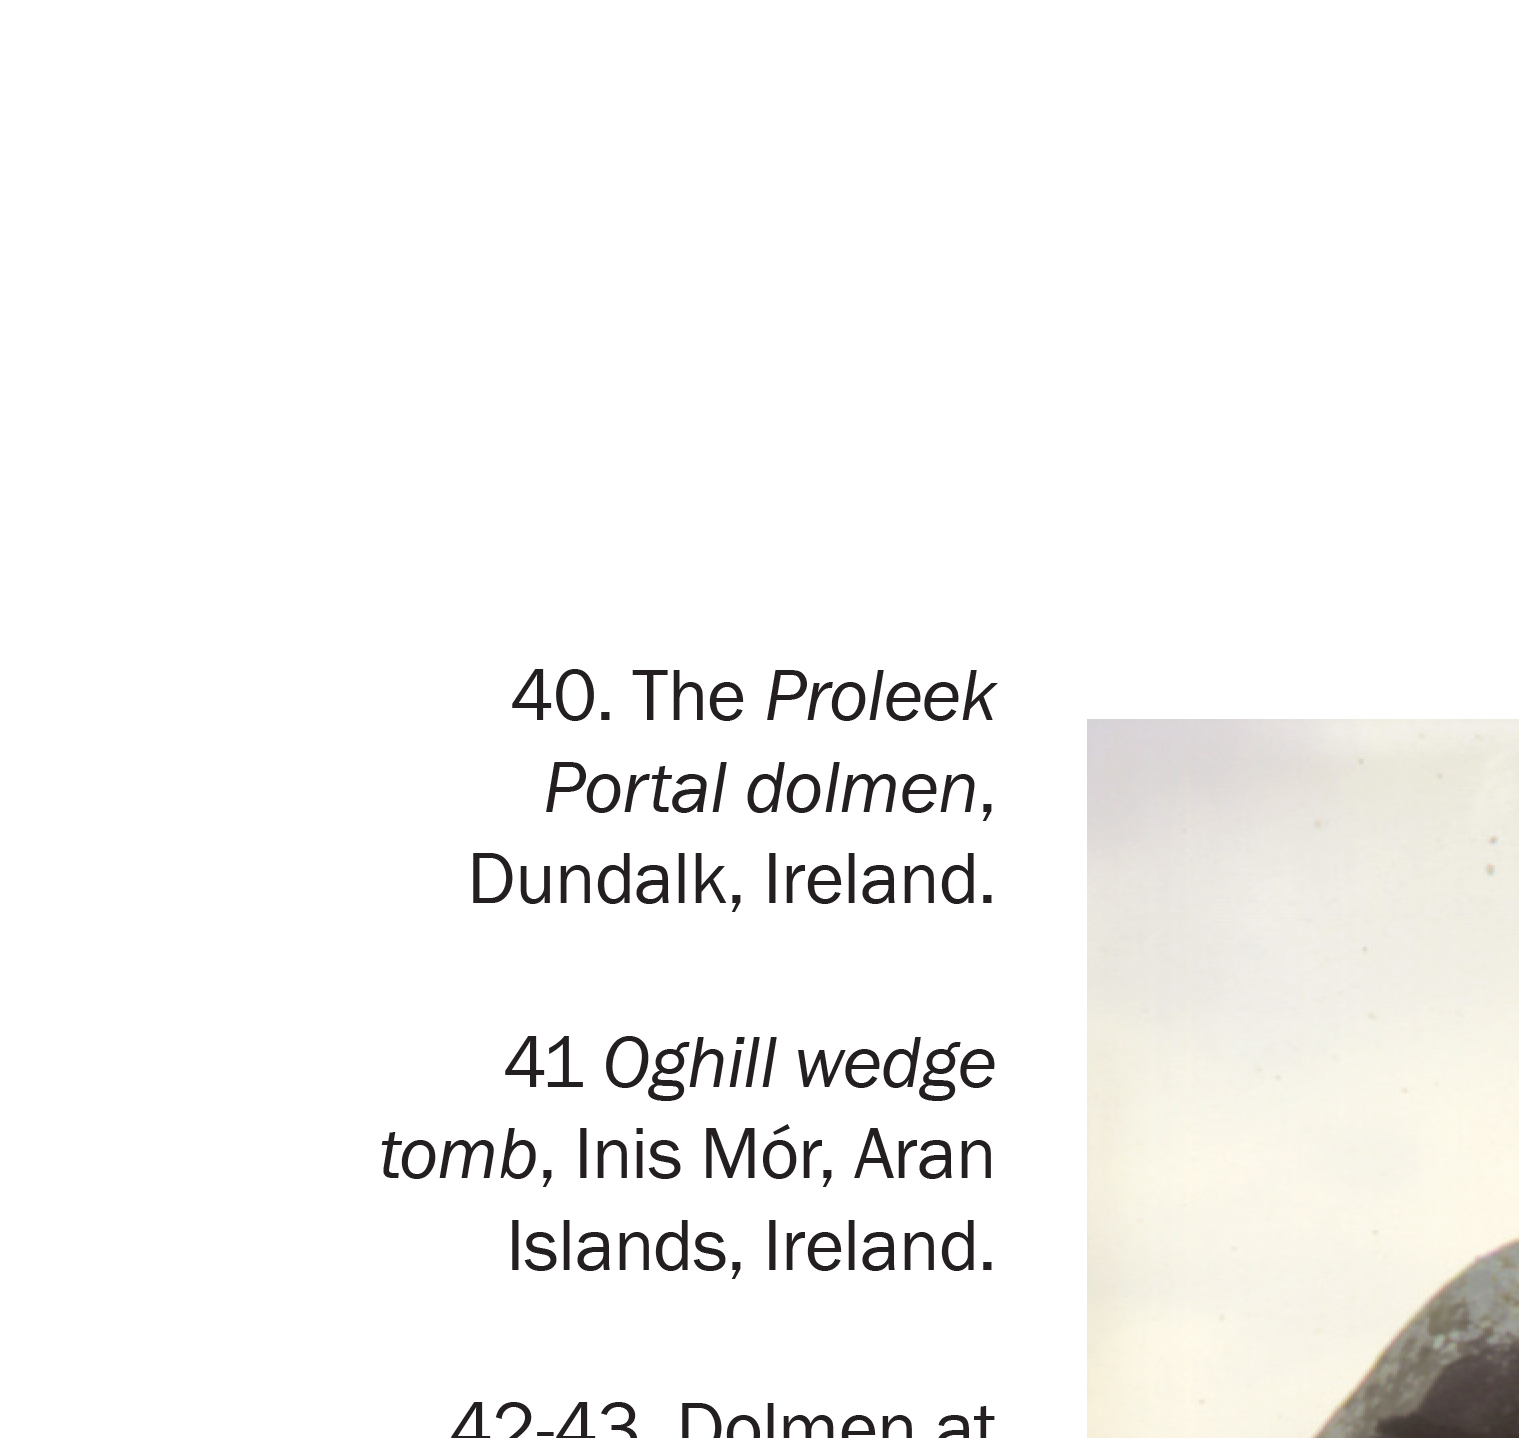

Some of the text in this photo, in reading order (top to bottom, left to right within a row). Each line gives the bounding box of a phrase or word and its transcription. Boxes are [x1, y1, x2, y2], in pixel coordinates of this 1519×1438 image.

[512, 669, 998, 721] 40. The Proleek
[546, 762, 992, 821] Portal dolmen,
[473, 853, 992, 912] Dundalk, Ireland.
[505, 1036, 995, 1101] 41 Oghill wedge
[382, 1124, 991, 1187] tomb, Inis Mór, Aran
[512, 1220, 992, 1279] Islands, Ireland.
